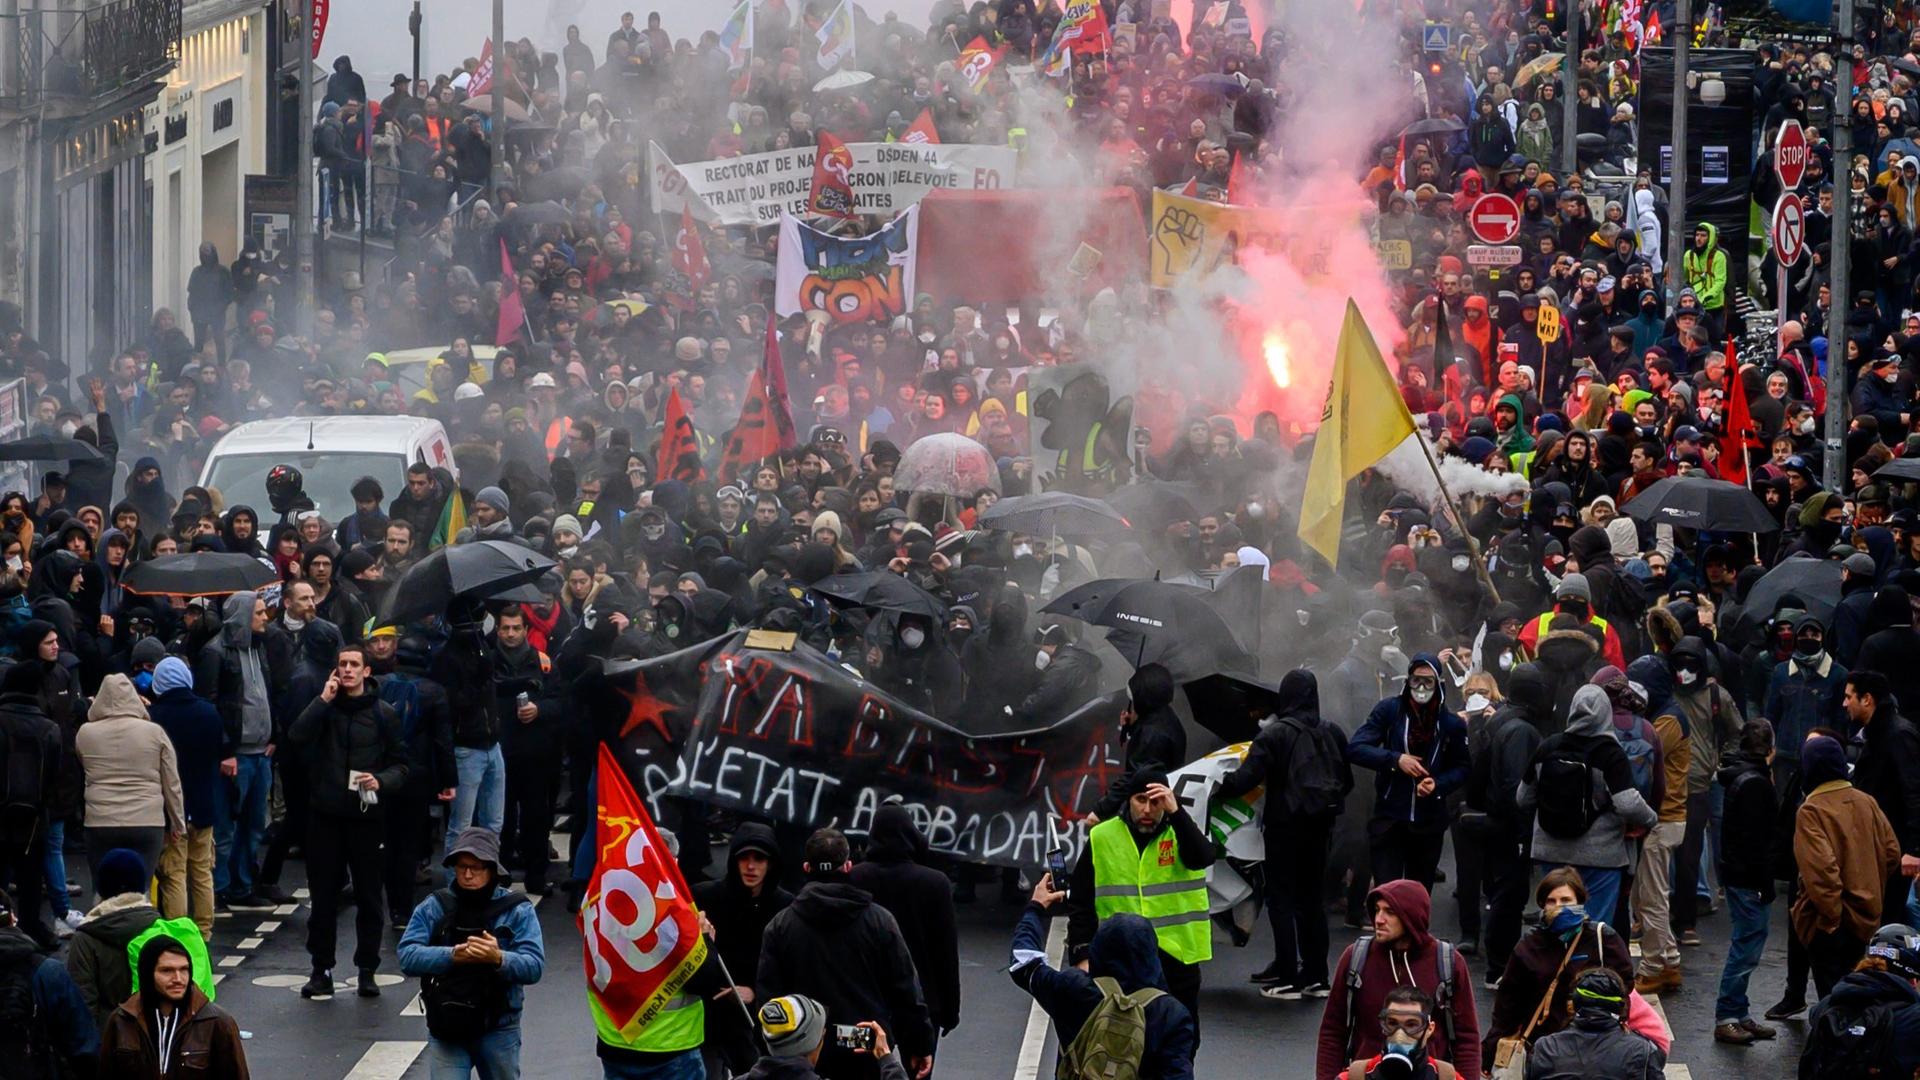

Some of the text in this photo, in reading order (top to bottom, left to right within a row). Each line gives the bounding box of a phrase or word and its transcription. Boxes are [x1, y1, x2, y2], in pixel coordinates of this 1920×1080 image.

[312, 0, 323, 39] BAC
[705, 159, 770, 182] RECTORAT
[776, 157, 791, 172] DE
[877, 148, 918, 163] DSDEN
[924, 151, 937, 165] 44
[1781, 147, 1803, 166] STOP
[700, 188, 746, 206] TRAIT
[750, 185, 765, 201] DU
[770, 177, 813, 198] PROJE
[848, 172, 885, 188] CRON
[758, 193, 892, 220] SUR LES AITES
[799, 265, 906, 324] CON
[1543, 310, 1552, 321] NO
[1539, 323, 1556, 337] WAY
[1116, 612, 1163, 628] INESIS
